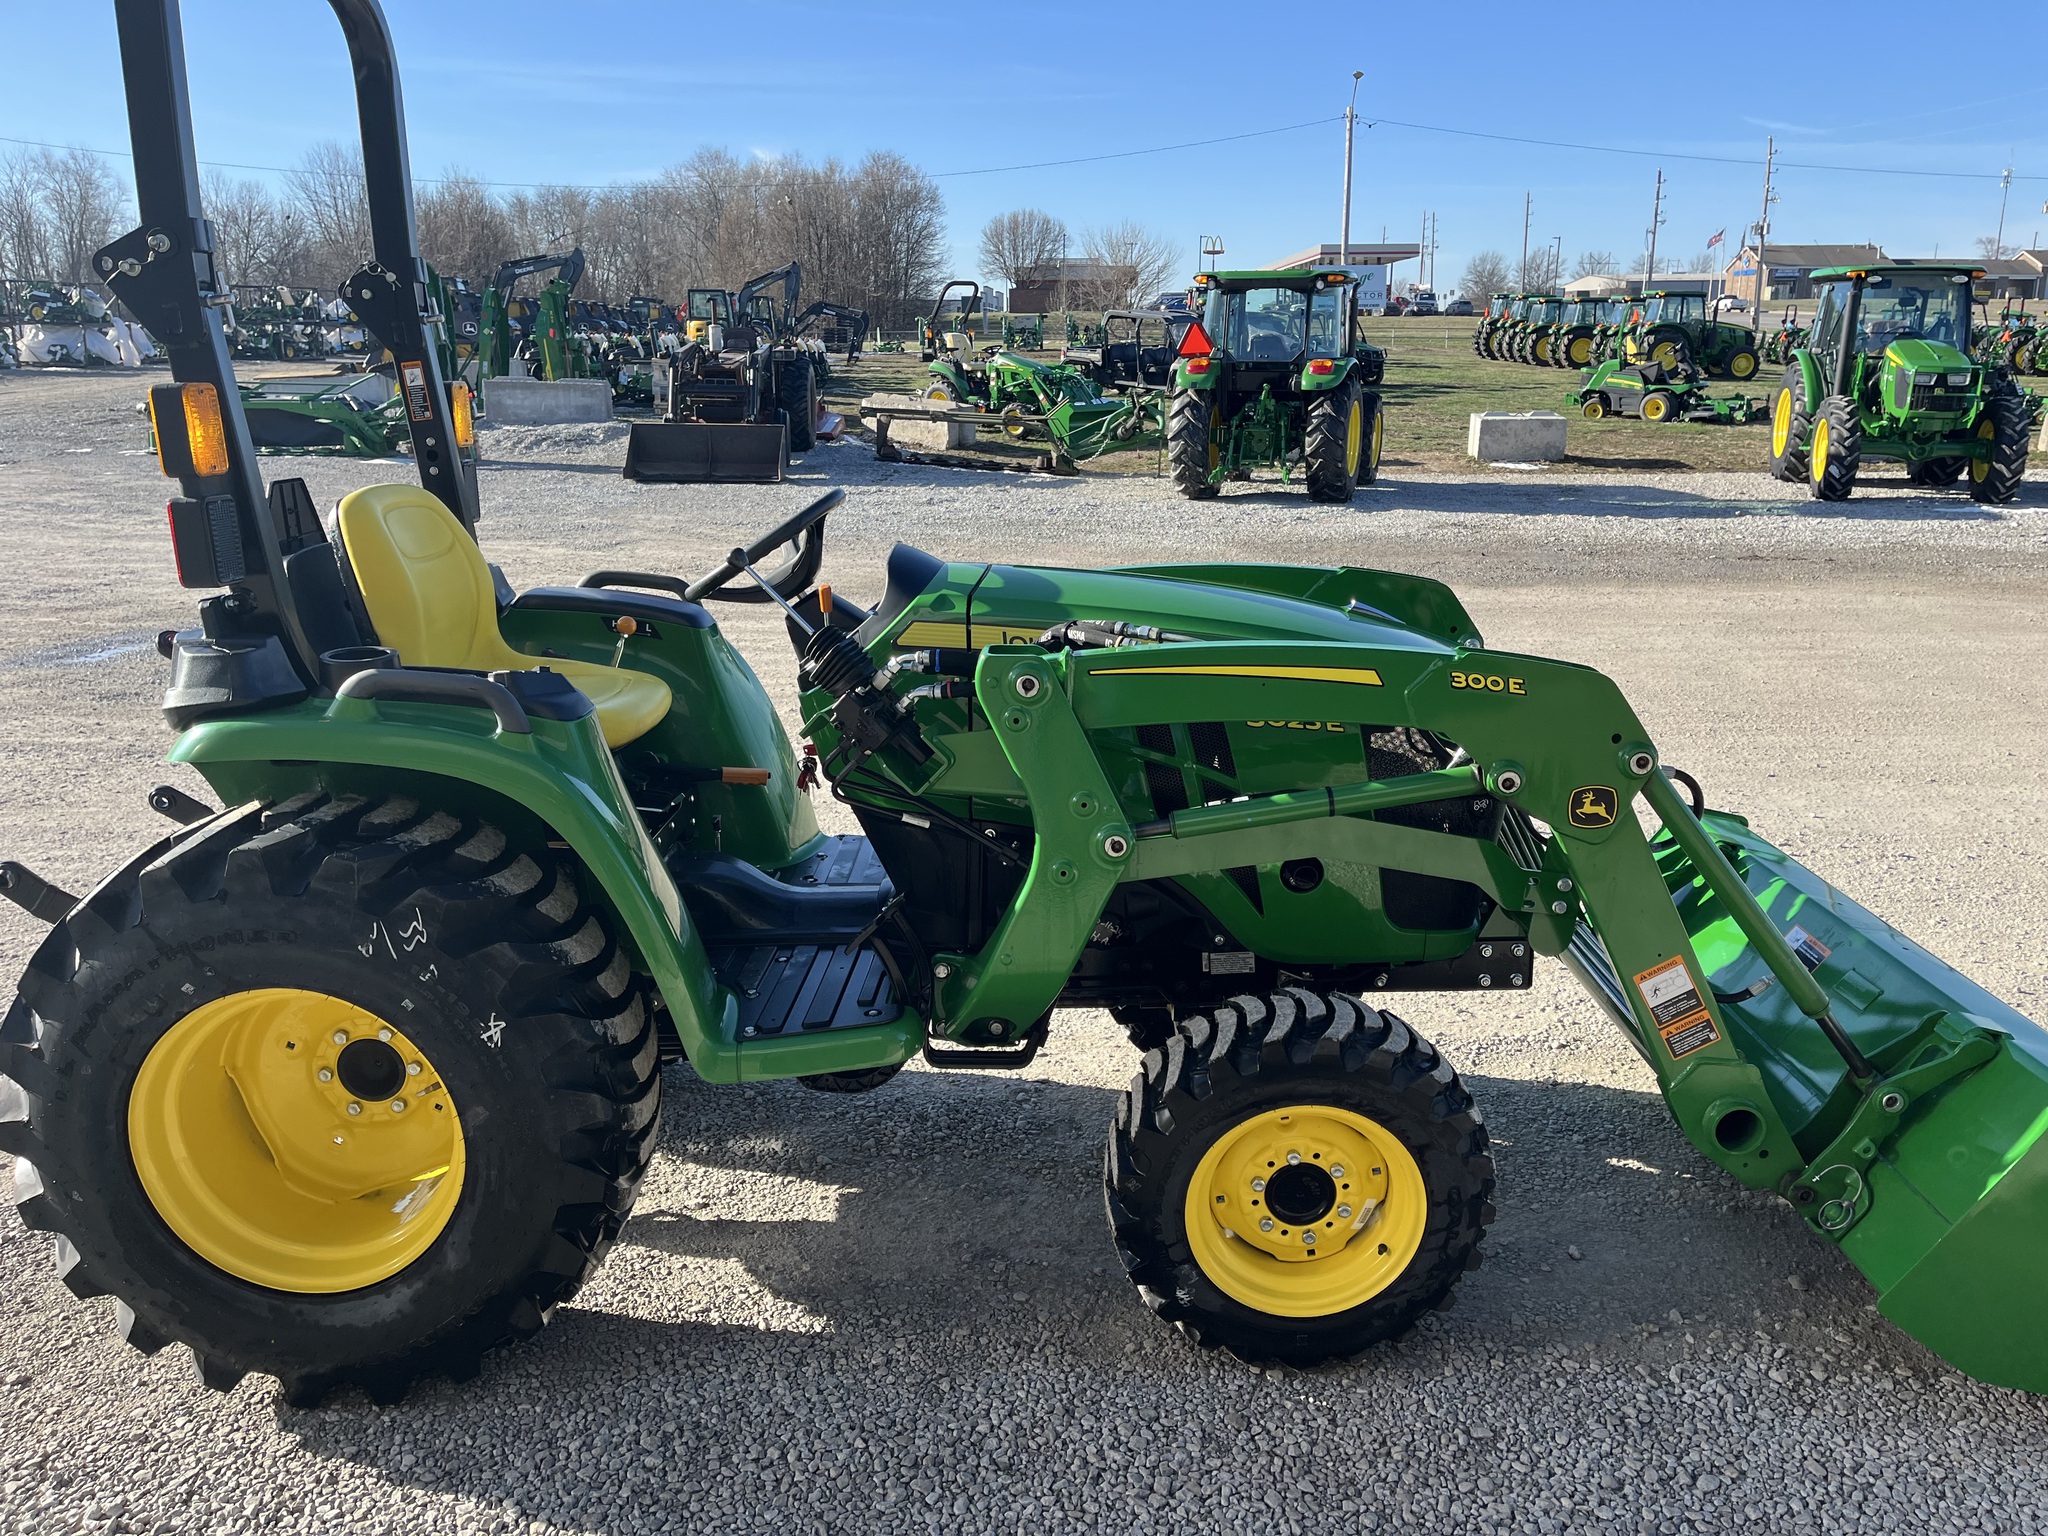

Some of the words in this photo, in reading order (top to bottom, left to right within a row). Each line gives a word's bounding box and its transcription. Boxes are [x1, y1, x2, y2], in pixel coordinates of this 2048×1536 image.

[514, 265, 535, 275] DEERE
[1360, 272, 1376, 287] ge
[646, 623, 652, 632] L
[1451, 672, 1526, 695] 300E
[1646, 959, 1678, 978] WARNING
[1674, 1014, 1705, 1032] WARNING
